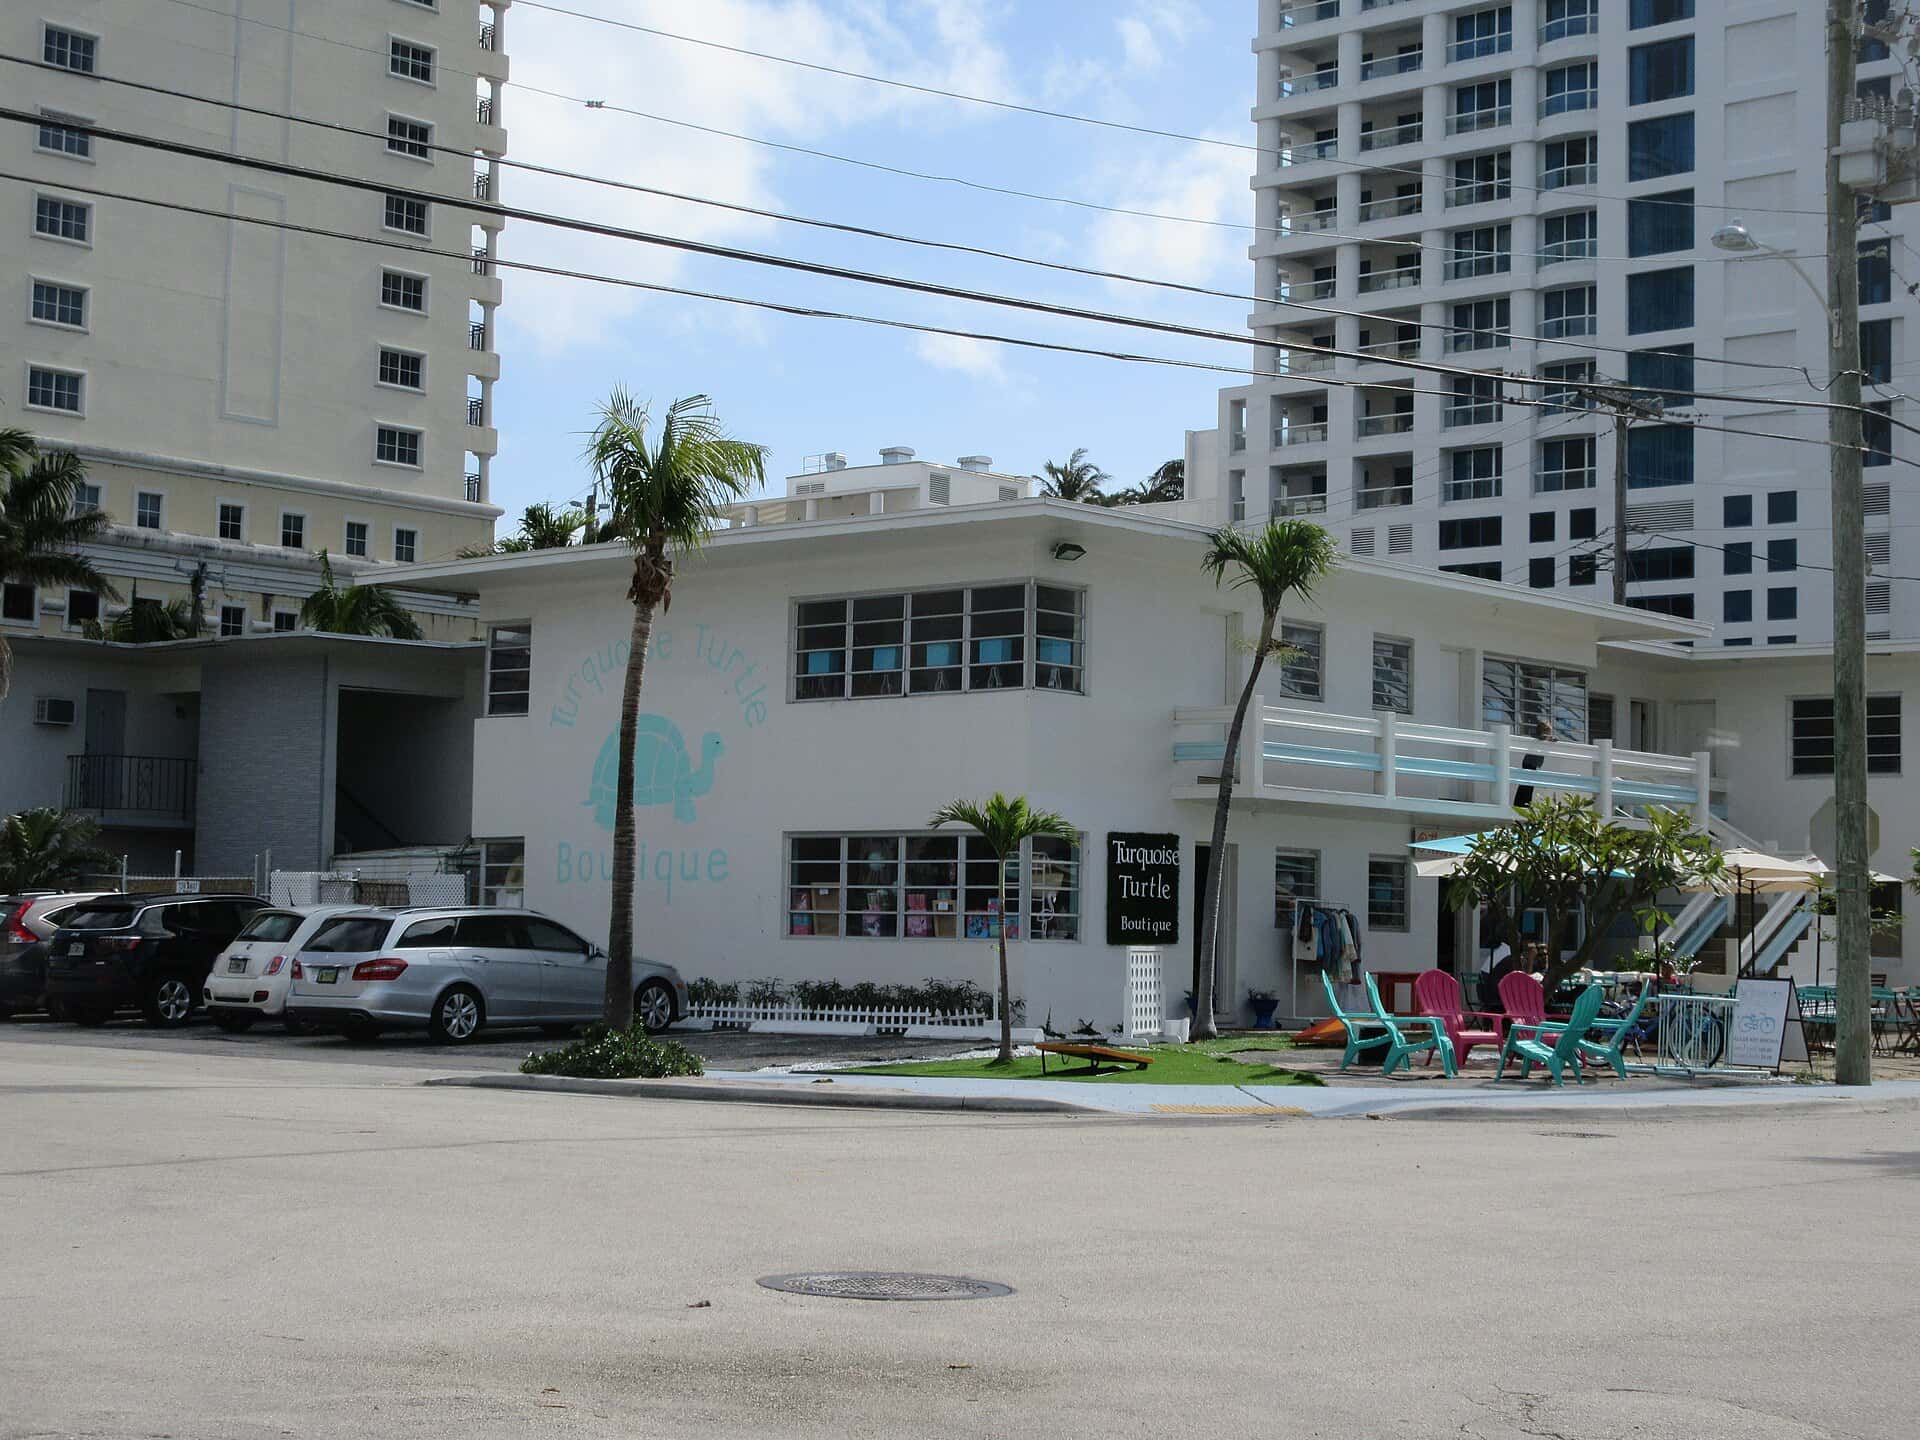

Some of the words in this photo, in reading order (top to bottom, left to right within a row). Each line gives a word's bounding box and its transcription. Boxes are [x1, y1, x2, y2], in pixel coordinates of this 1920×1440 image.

[550, 631, 673, 728] Turquoe
[696, 623, 768, 728] Turtle
[1113, 840, 1180, 871] Turquoise
[556, 841, 729, 905] Bouique
[1119, 873, 1171, 899] Turtle
[1121, 915, 1172, 937] Boutique
